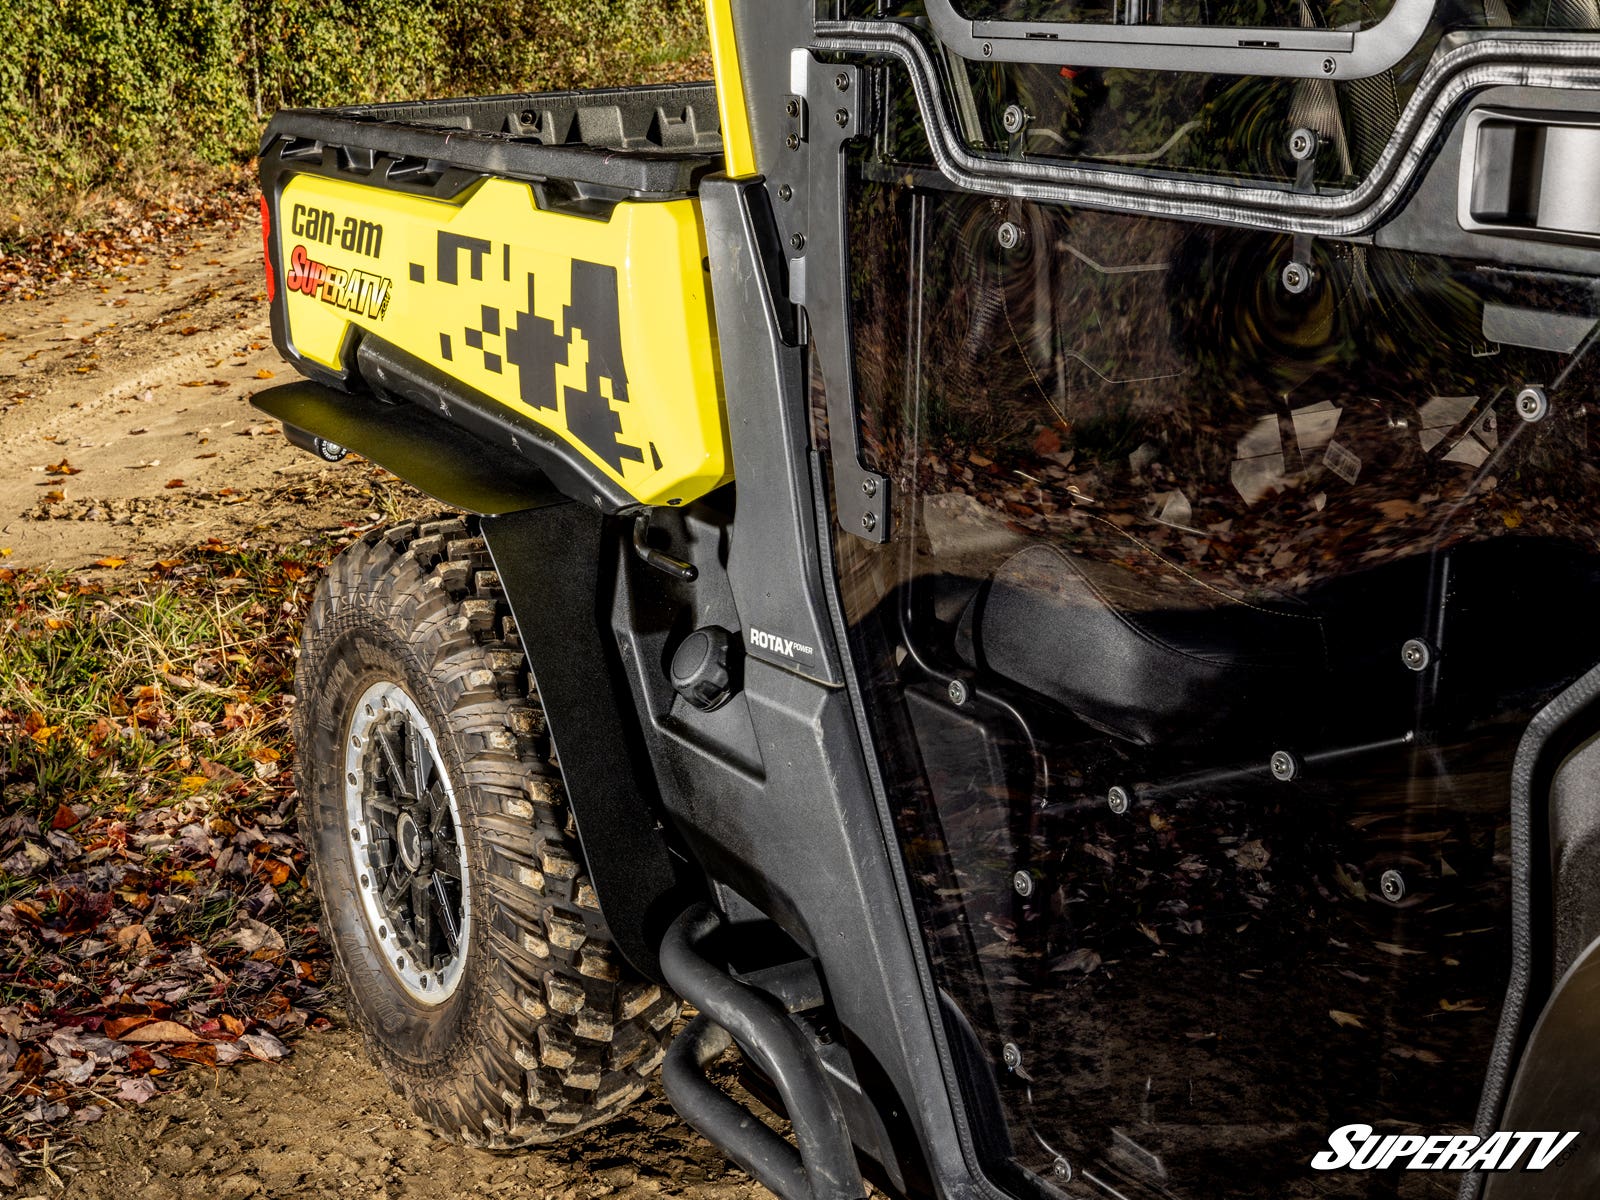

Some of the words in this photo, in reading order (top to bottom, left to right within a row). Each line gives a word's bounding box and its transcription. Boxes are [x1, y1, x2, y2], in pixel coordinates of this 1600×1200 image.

[291, 203, 383, 259] can-am
[287, 244, 391, 320] SUPERATV
[750, 627, 794, 657] ROTAX
[793, 642, 813, 655] POWER
